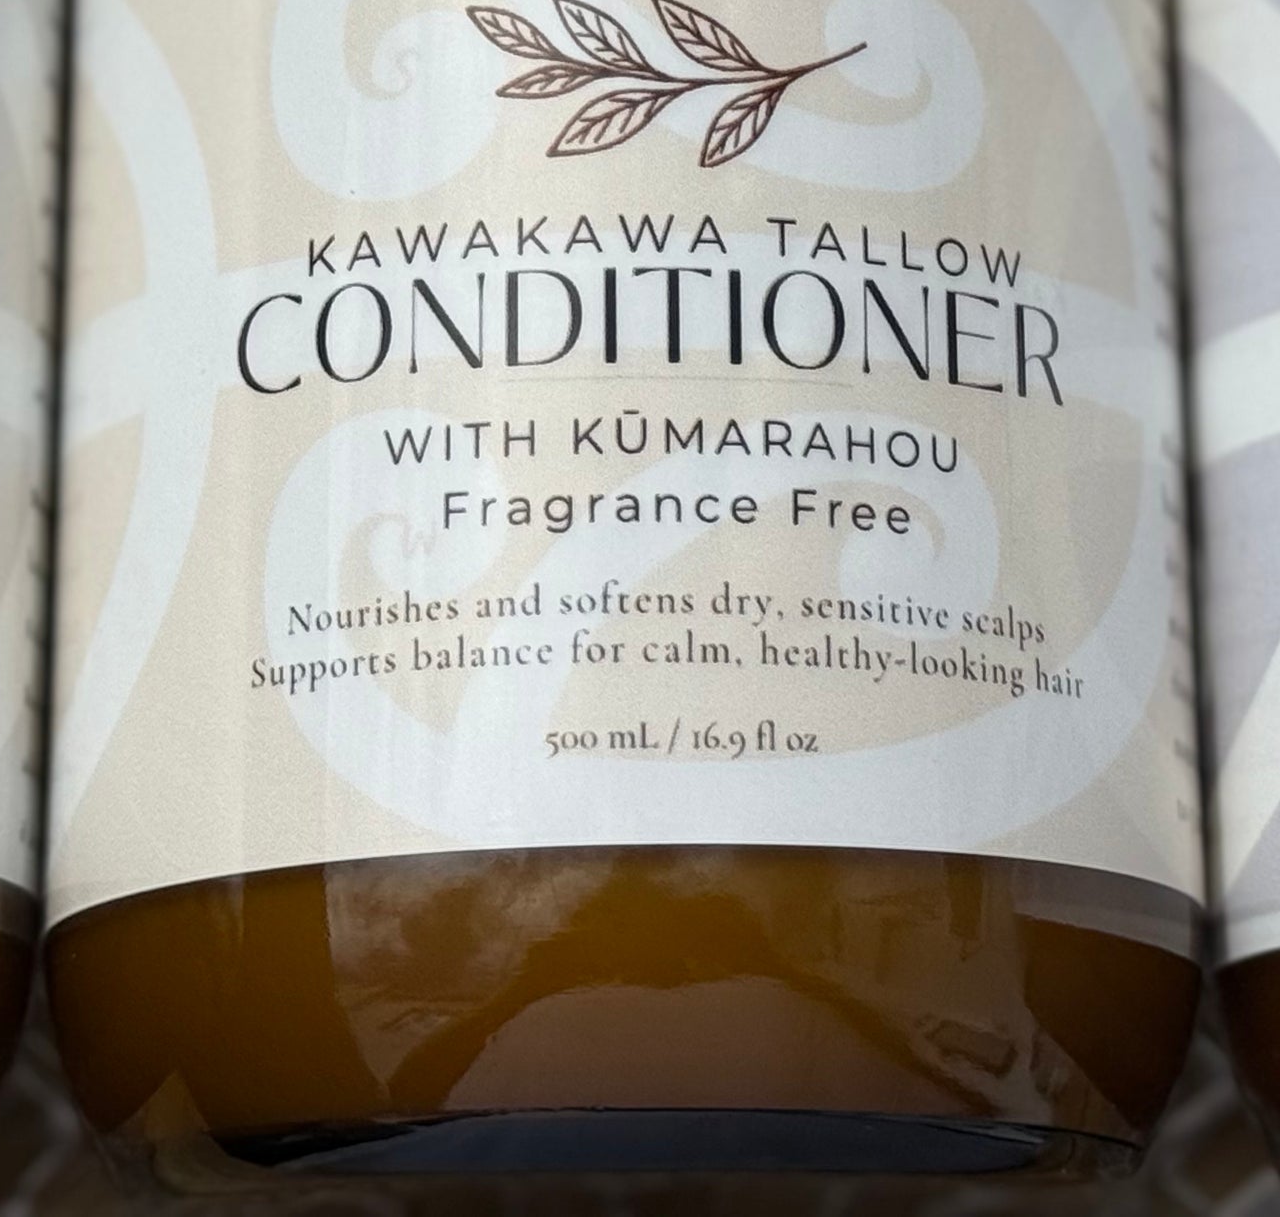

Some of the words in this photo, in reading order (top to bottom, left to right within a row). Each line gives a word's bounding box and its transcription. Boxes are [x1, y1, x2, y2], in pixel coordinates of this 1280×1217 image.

[308, 213, 728, 278] KAWAKAWA
[763, 217, 1021, 289] TALLOW
[236, 265, 1064, 406] CONDITIONER
[383, 419, 536, 466] WITH
[572, 409, 958, 474] KŪMARAHOU
[443, 490, 759, 535] Fragrance
[791, 488, 911, 536] Free
[287, 589, 460, 636] Nourishes
[475, 582, 542, 619] and
[559, 578, 695, 615] softens
[710, 580, 784, 628] dry,
[800, 593, 950, 630] sensitive
[961, 604, 1046, 653] scalps
[250, 652, 397, 696] Supports
[411, 633, 553, 672] balance
[571, 628, 626, 665] for
[641, 628, 743, 668] calm,
[759, 630, 1026, 699] healthy-looking
[1034, 656, 1084, 699] hair
[545, 730, 599, 758] 500
[608, 721, 660, 750] mL
[666, 716, 682, 756] /
[692, 721, 747, 761] 16.9
[756, 719, 777, 752] fl
[785, 732, 819, 754] oz
